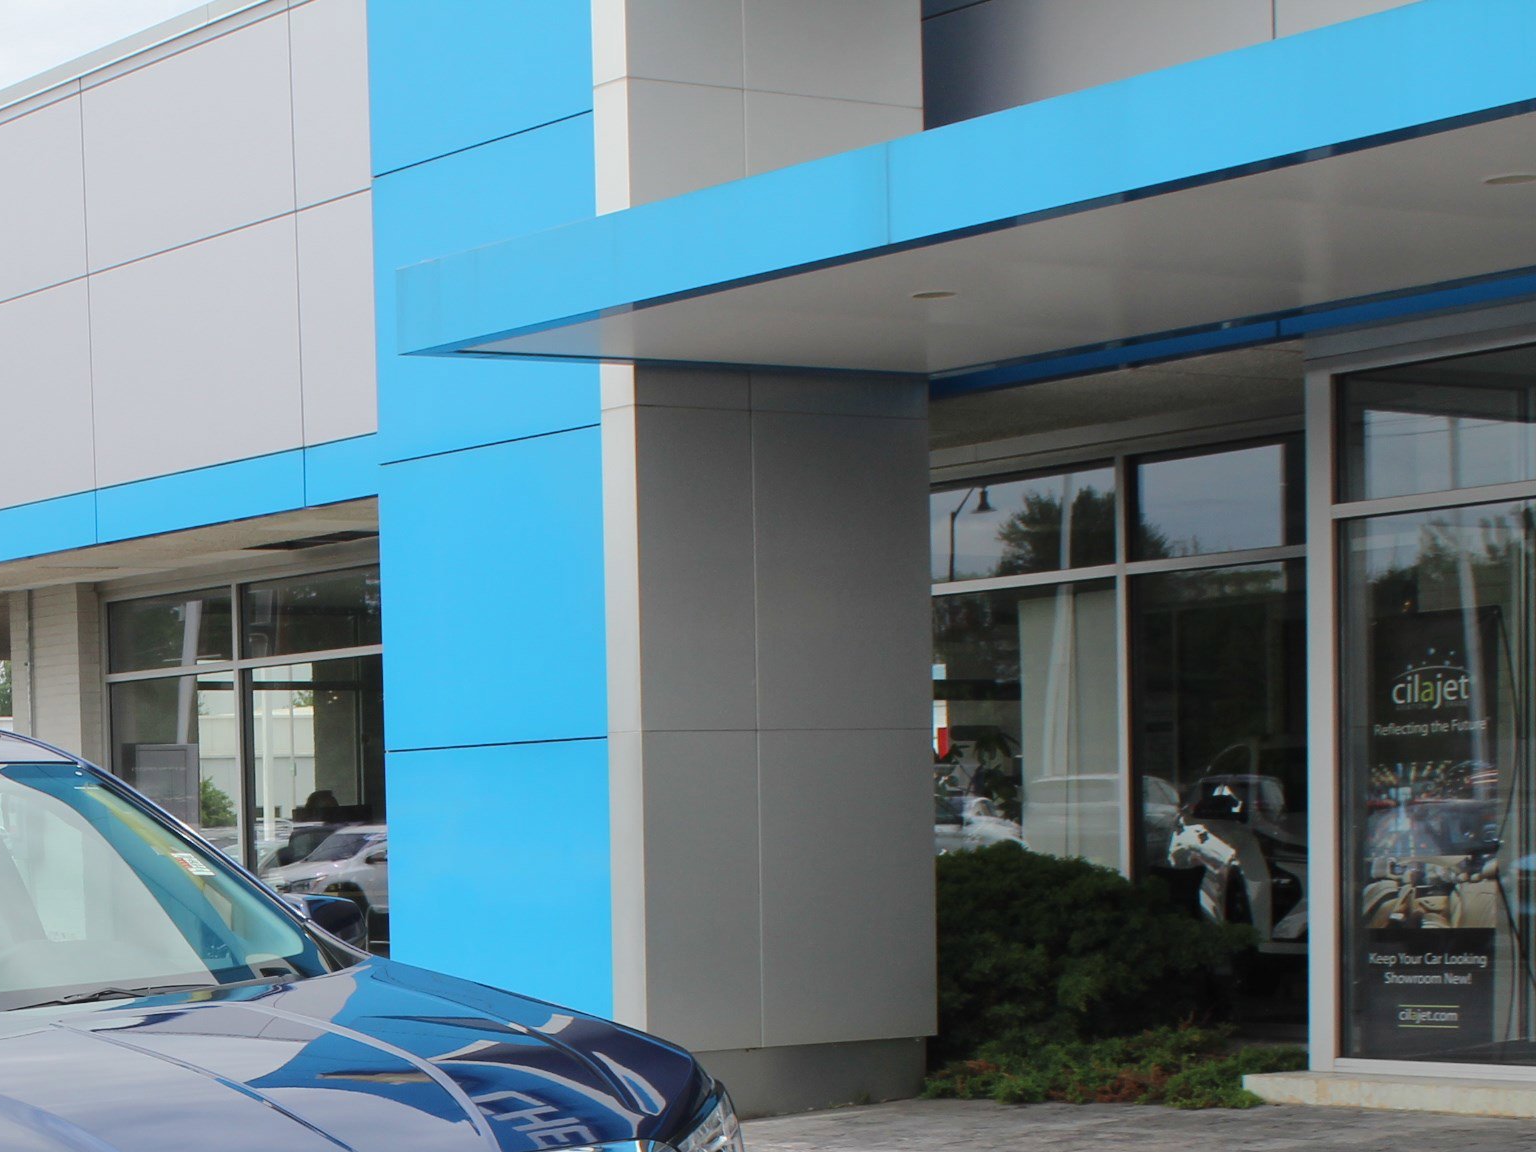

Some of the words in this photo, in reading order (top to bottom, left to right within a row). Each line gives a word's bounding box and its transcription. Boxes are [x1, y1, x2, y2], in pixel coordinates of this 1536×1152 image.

[1392, 673, 1470, 709] cilajet
[1373, 722, 1429, 737] Reflecting
[1431, 720, 1450, 733] the
[1368, 952, 1397, 967] Keep
[1398, 952, 1423, 965] Your
[1424, 952, 1443, 965] Car
[1444, 952, 1488, 968] Looking
[1384, 971, 1442, 985] Showroom
[1443, 972, 1472, 985] New!
[1398, 1008, 1459, 1024] cilajet.com
